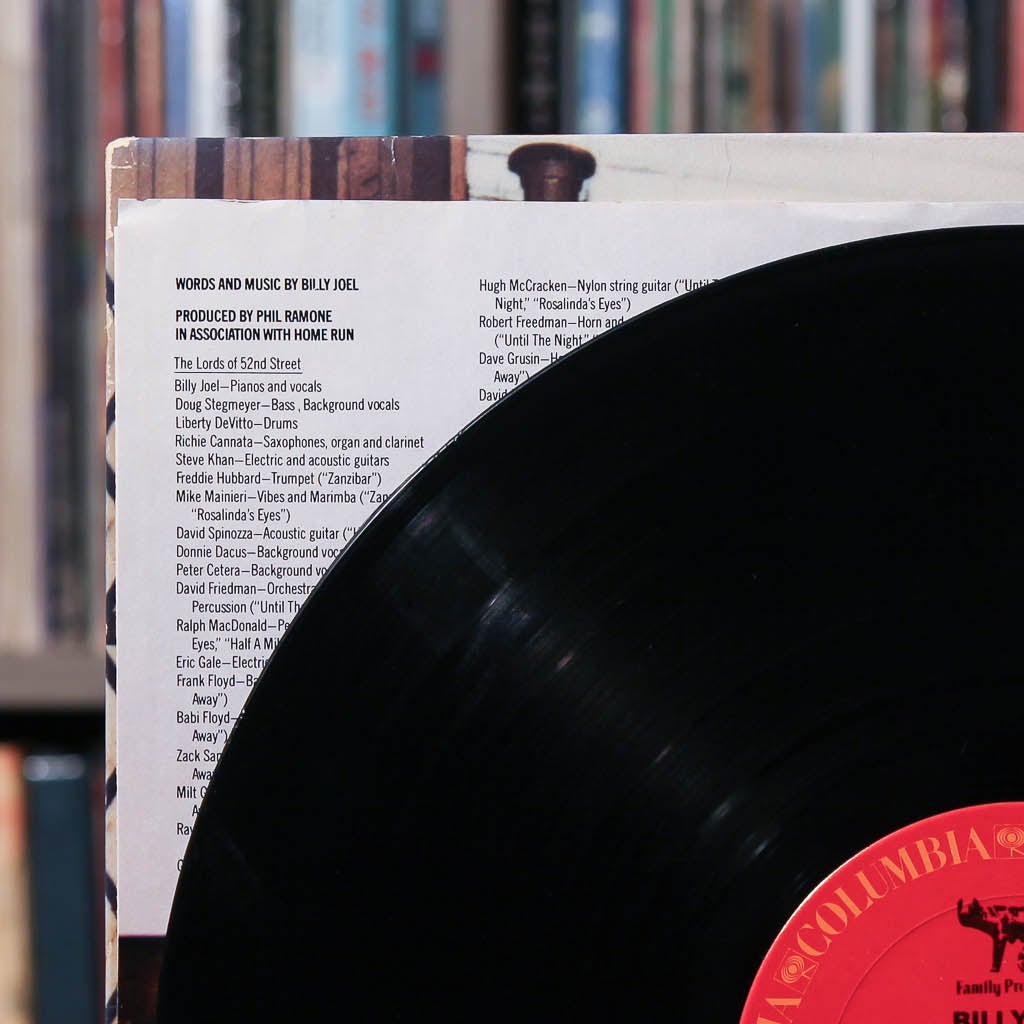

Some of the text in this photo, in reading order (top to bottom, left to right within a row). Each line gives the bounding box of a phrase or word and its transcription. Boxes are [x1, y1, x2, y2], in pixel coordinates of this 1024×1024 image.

[176, 277, 359, 291] WORDS AND MUSIC BY BILLY JOEL
[480, 279, 506, 294] Hugh
[609, 279, 639, 294] string
[641, 279, 671, 296] guitar
[176, 309, 333, 323] PRODUCED BY PHIL RAMONE
[479, 315, 513, 328] Robert
[605, 315, 624, 328] and
[176, 328, 354, 341] IN ASSOCIATION WITH HOME RUN
[532, 334, 551, 346] The
[173, 356, 301, 370] The Lords of 52nd Street
[479, 352, 504, 364] Dave
[175, 379, 197, 395] Billy
[267, 380, 287, 392] and
[290, 380, 322, 392] vocals
[479, 388, 507, 401] David
[176, 397, 202, 413] Doug
[304, 398, 364, 413] Background
[367, 397, 400, 411] vocals
[176, 416, 211, 431] Liberty
[175, 434, 207, 447] Richie
[331, 438, 360, 450] organ
[363, 435, 382, 448] and
[385, 435, 424, 448] clarinet
[176, 452, 204, 466] Steve
[286, 453, 305, 466] and
[308, 454, 351, 466] acoustic
[354, 454, 389, 469] guitars
[177, 471, 213, 484] Freddie
[176, 489, 201, 503] Mike
[287, 490, 307, 503] and
[310, 490, 356, 503] Marimba
[177, 526, 205, 539] David
[309, 526, 340, 542] guitar
[177, 545, 212, 558] Donnie
[321, 549, 339, 559] voc
[177, 563, 204, 576] Peter
[316, 567, 327, 577] vo
[176, 581, 205, 594] David
[192, 600, 246, 613] Percussion
[288, 600, 300, 615] Th
[177, 619, 205, 634] Ralph
[254, 637, 261, 650] A
[176, 656, 195, 668] Eric
[177, 674, 205, 687] Frank
[177, 711, 199, 724] Babi
[177, 749, 200, 762] Zack
[177, 785, 197, 799] Milt
[796, 826, 993, 957] COLUMBIA
[956, 980, 1001, 997] Family
